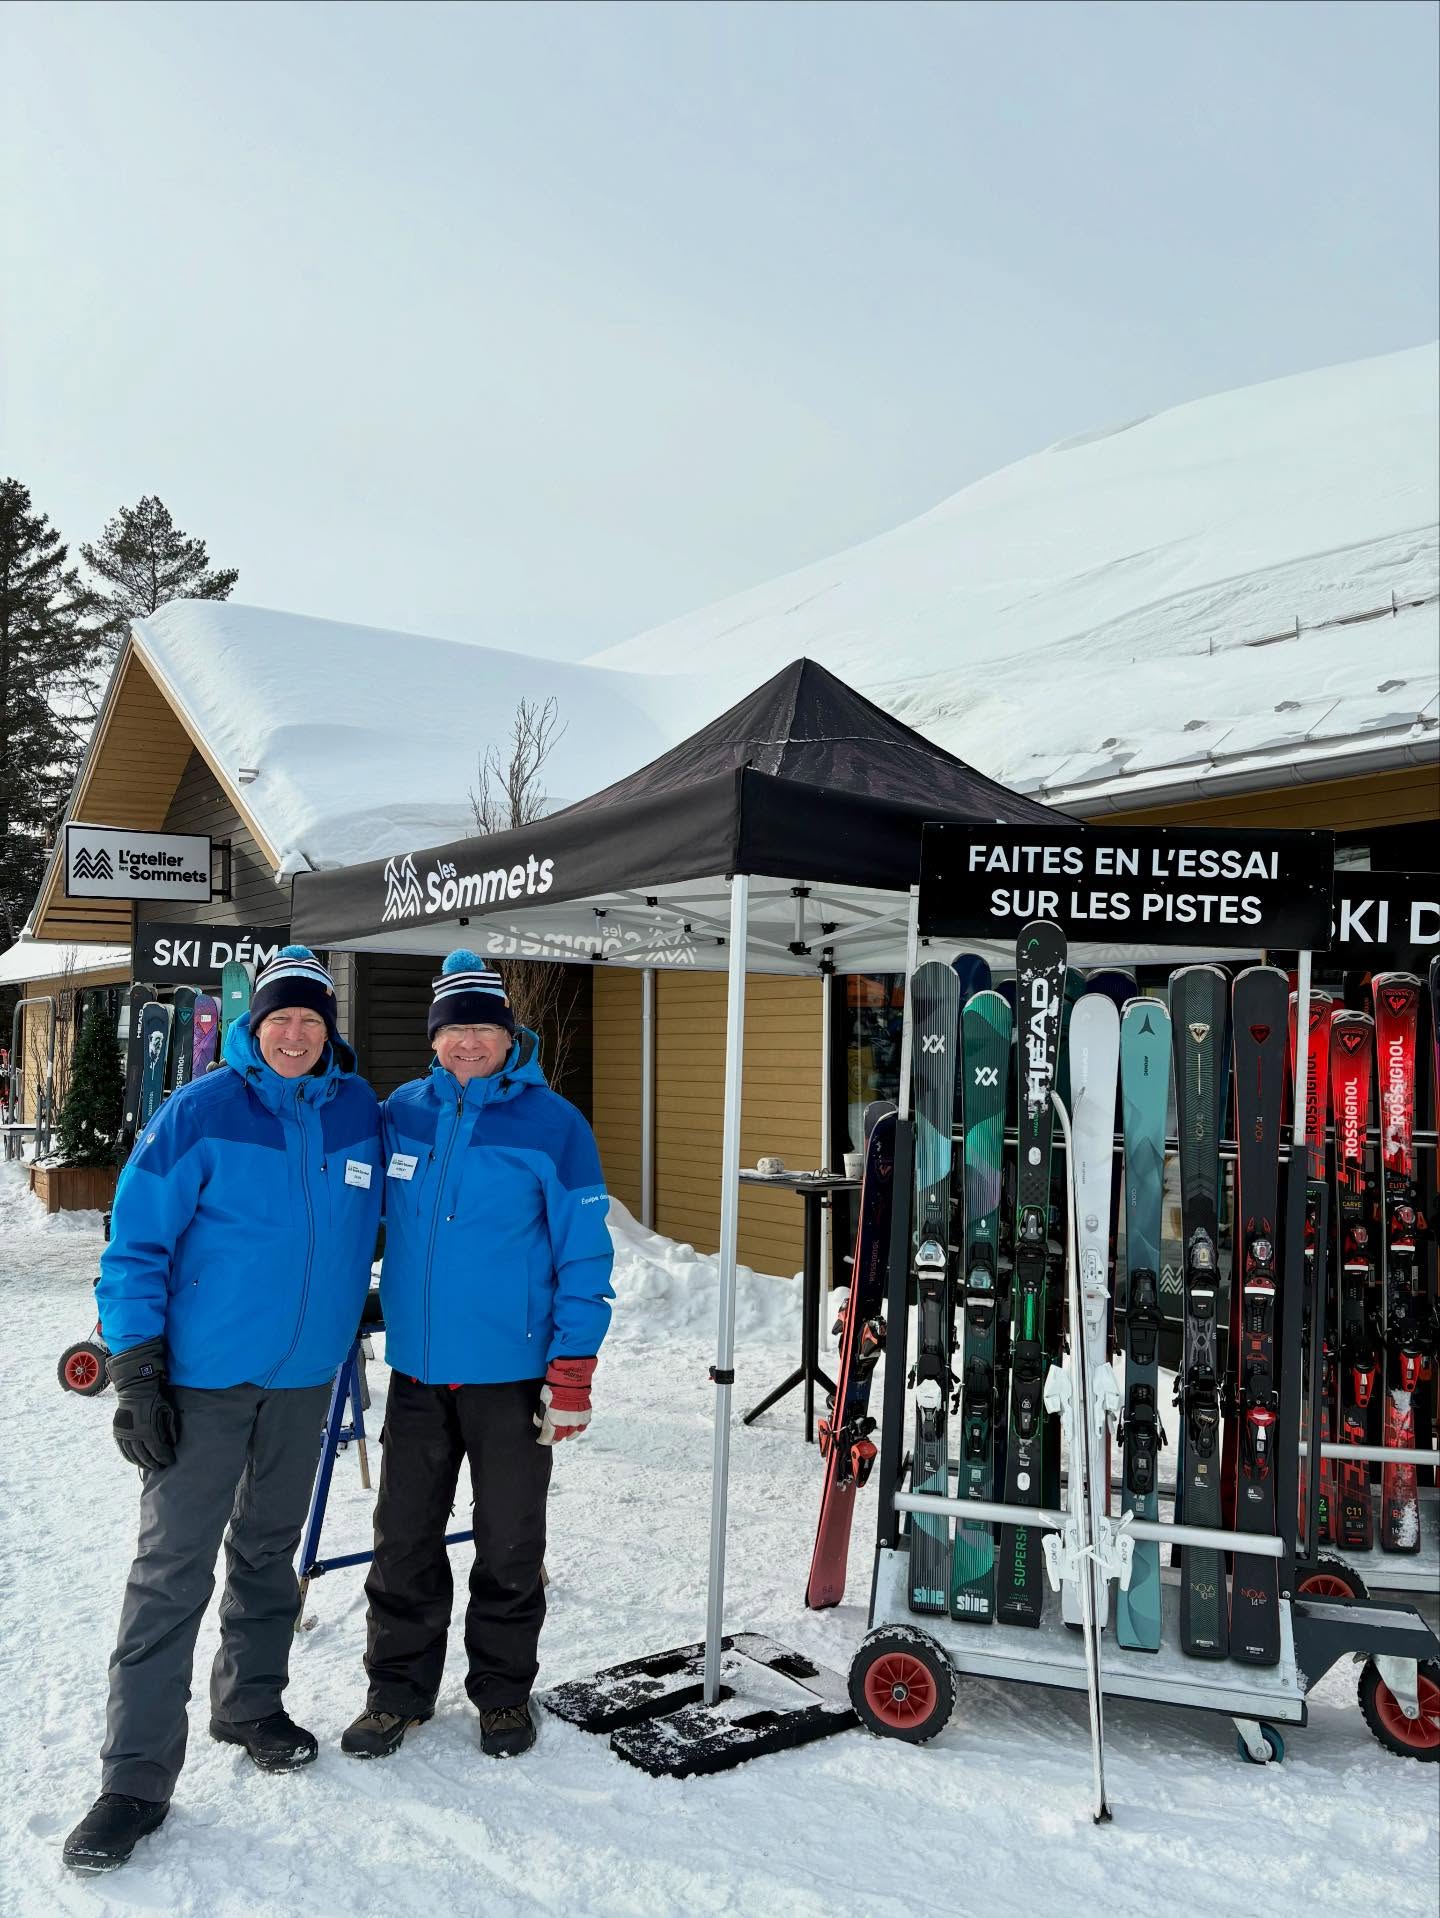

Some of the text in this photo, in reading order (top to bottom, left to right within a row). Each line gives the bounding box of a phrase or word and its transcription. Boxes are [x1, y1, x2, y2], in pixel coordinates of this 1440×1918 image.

[119, 849, 184, 867] L'atelier
[129, 865, 207, 883] Sommets
[437, 860, 457, 880] les
[968, 845, 1279, 880] FAITES EN L'ESSAI
[424, 853, 555, 915] Sommets
[990, 888, 1262, 924] SUR LES PISTES
[1333, 899, 1388, 943] KI
[152, 938, 201, 968] SKI
[136, 1008, 144, 1039] HEAD
[1029, 977, 1049, 1101] HEAD
[176, 1054, 185, 1090] OSSIGNOL
[1345, 1077, 1359, 1158] ROSSIGNOL
[913, 1586, 945, 1605] shine
[956, 1593, 989, 1613] shine
